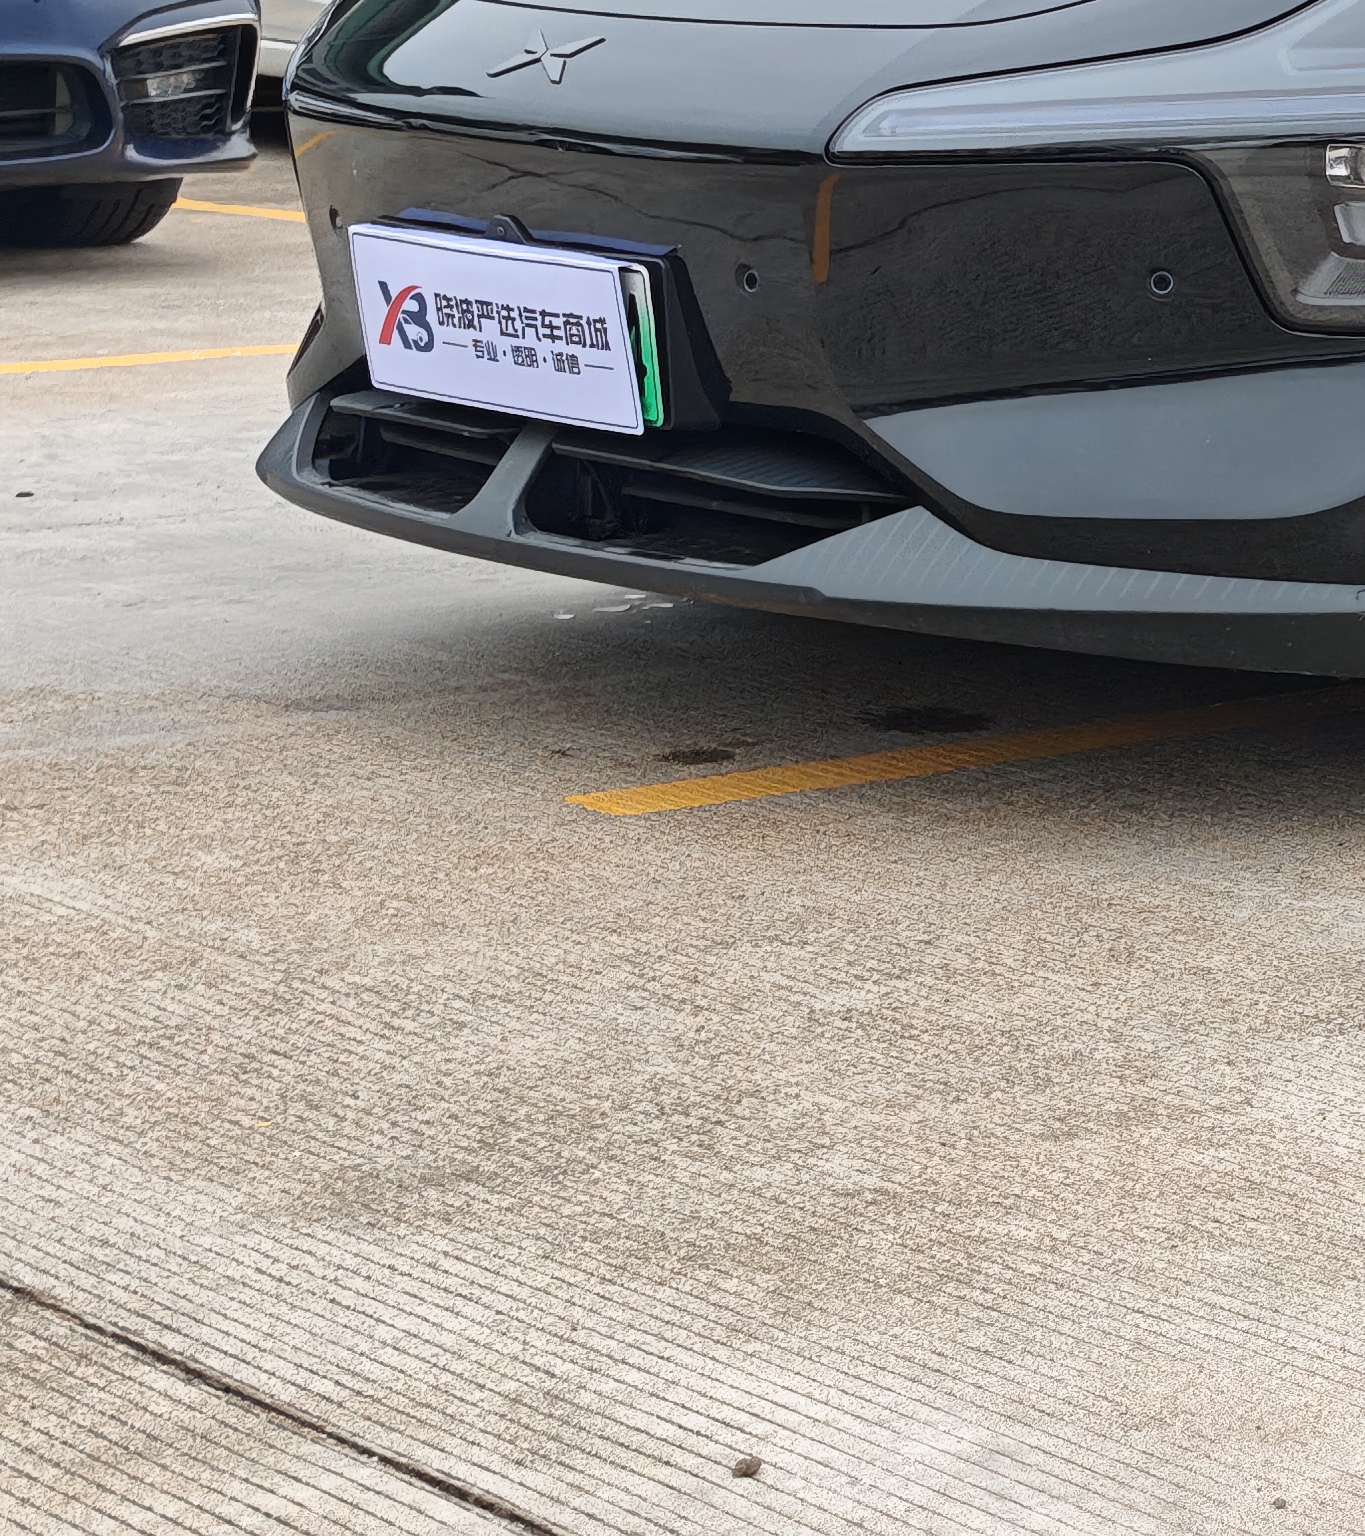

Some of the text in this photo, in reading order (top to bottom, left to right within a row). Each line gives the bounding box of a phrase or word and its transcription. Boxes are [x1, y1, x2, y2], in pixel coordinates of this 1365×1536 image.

[434, 292, 611, 351] 晓波严选汽车商城
